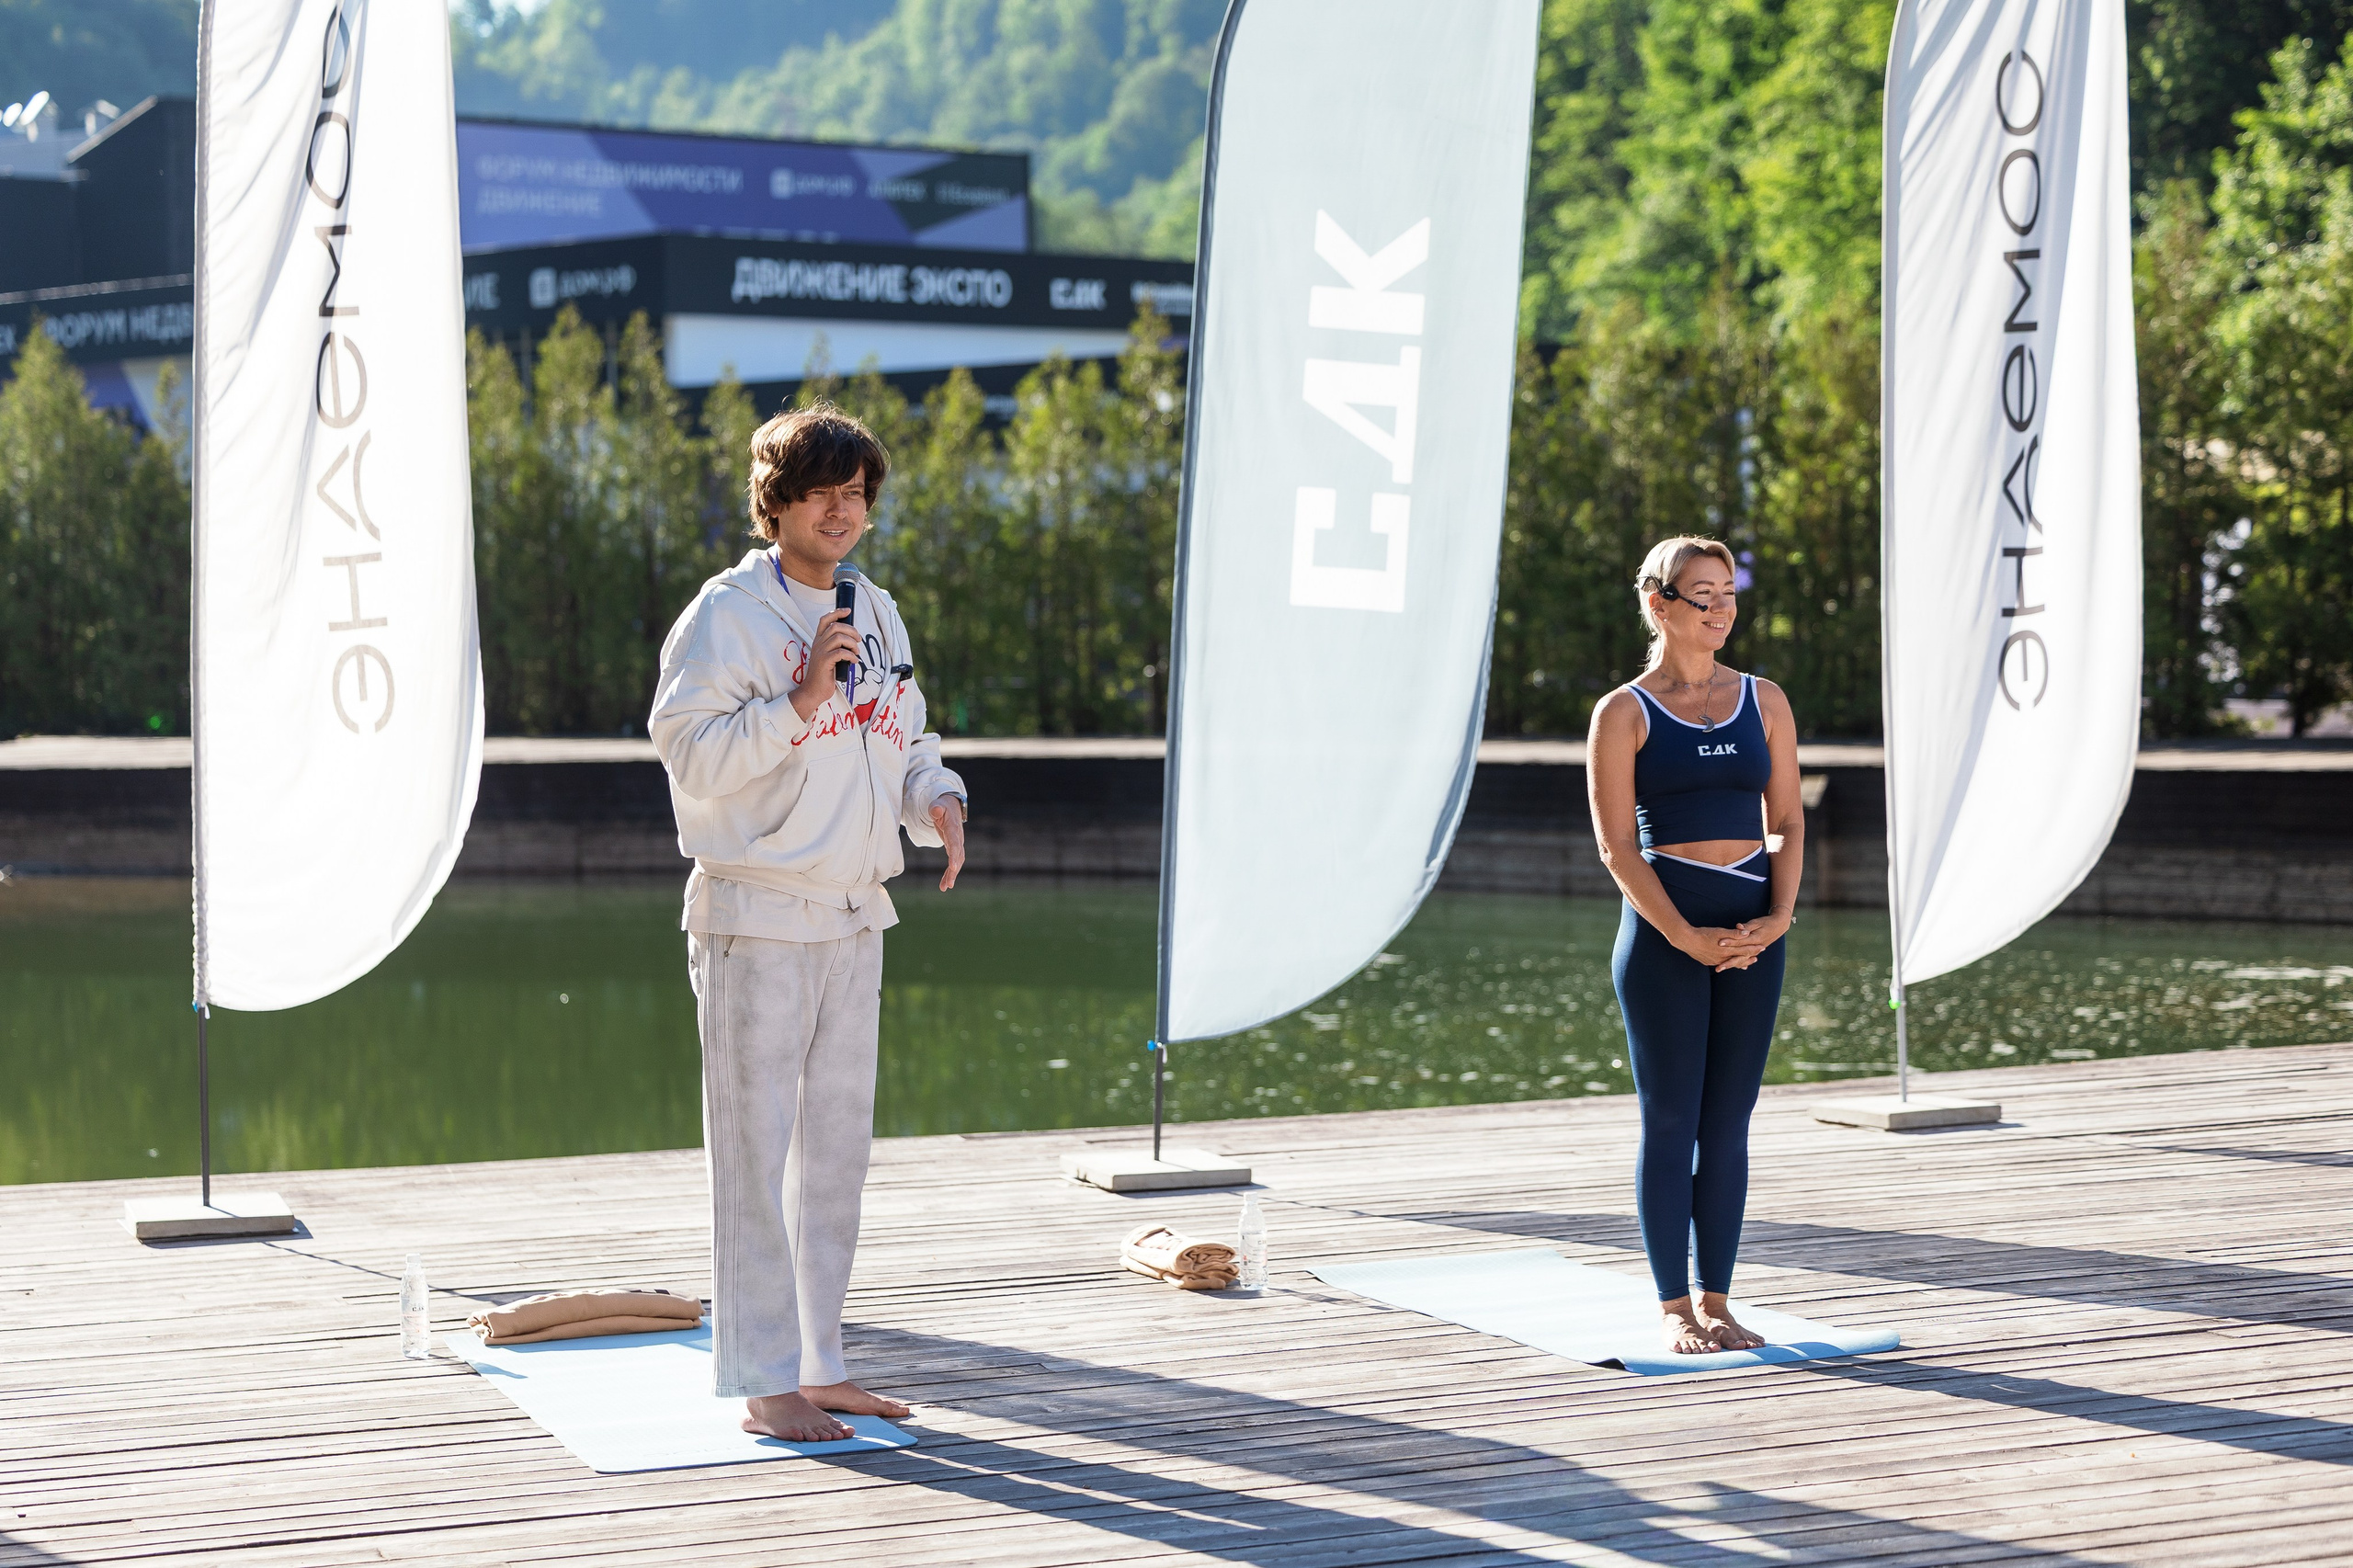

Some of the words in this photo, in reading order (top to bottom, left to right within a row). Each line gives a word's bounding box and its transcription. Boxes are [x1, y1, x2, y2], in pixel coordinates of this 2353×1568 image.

[733, 256, 908, 303] ДВИЖЕНИЕ
[910, 265, 1012, 309] ЭКСПО
[1698, 744, 1737, 756] СДК
